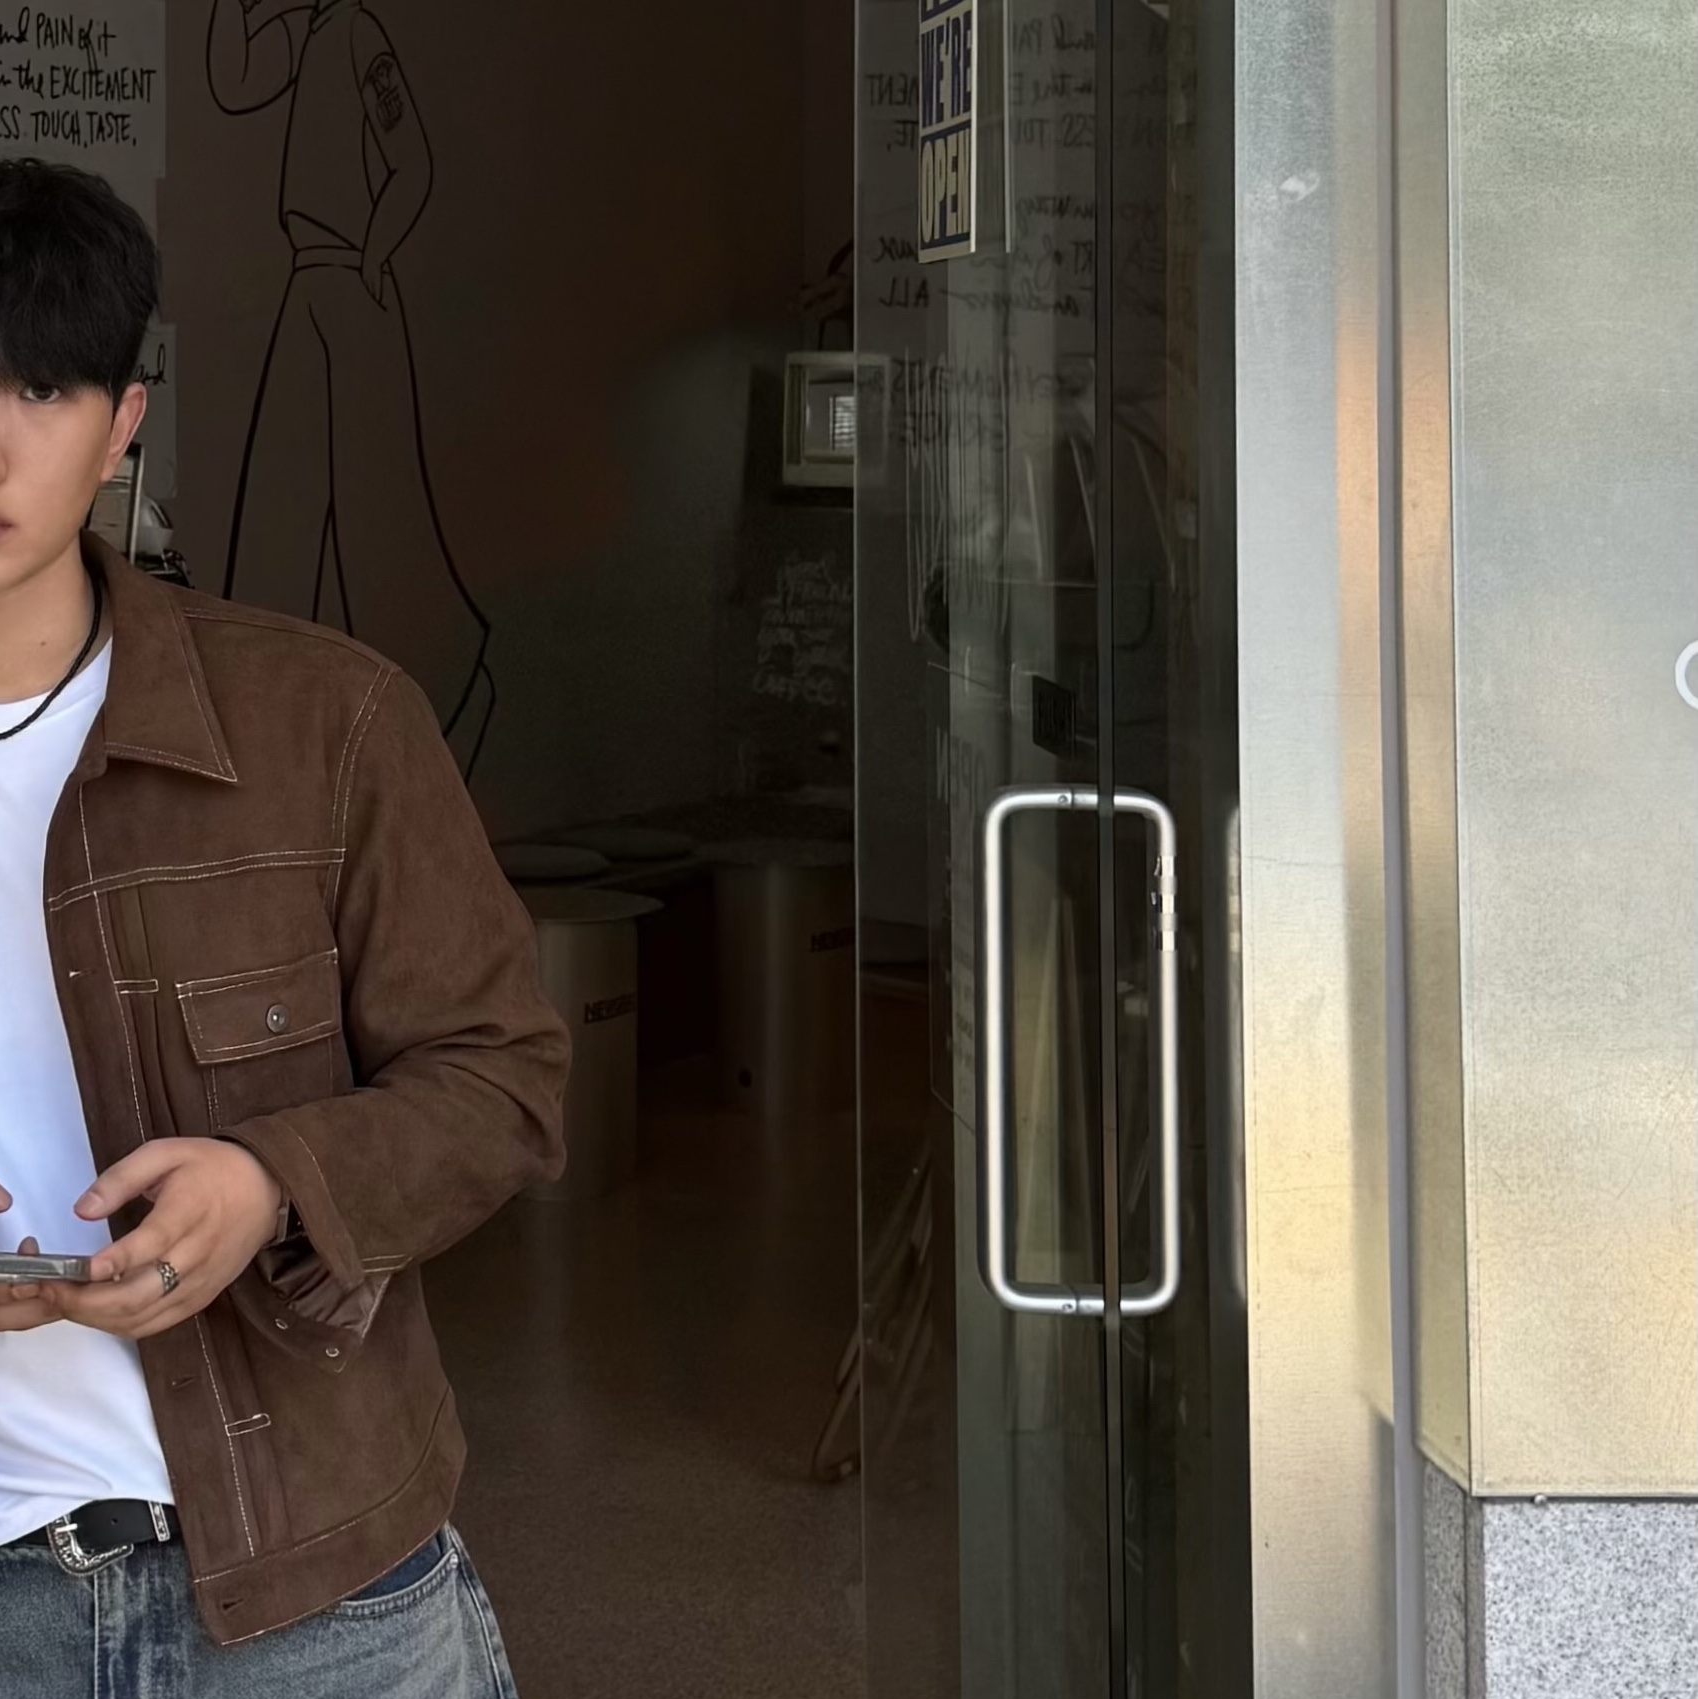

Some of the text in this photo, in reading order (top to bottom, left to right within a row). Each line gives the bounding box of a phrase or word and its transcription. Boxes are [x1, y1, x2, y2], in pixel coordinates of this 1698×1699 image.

[36, 14, 73, 50] PAIN
[13, 58, 44, 99] the
[50, 64, 156, 103] EXCITEMENT
[921, 128, 970, 244] OPEN
